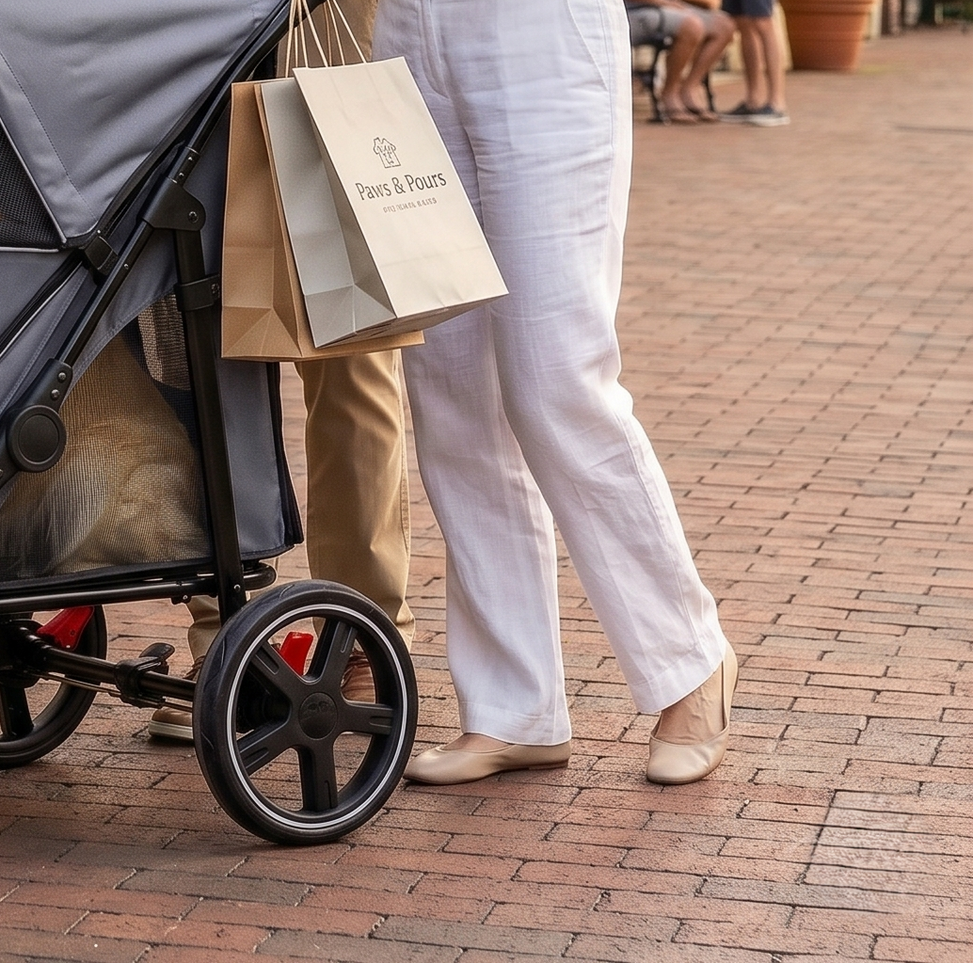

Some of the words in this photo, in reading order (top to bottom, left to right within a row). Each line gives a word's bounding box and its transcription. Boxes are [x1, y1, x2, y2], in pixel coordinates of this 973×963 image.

[355, 182, 392, 201] Paws
[391, 176, 406, 194] &
[404, 172, 447, 192] Pours
